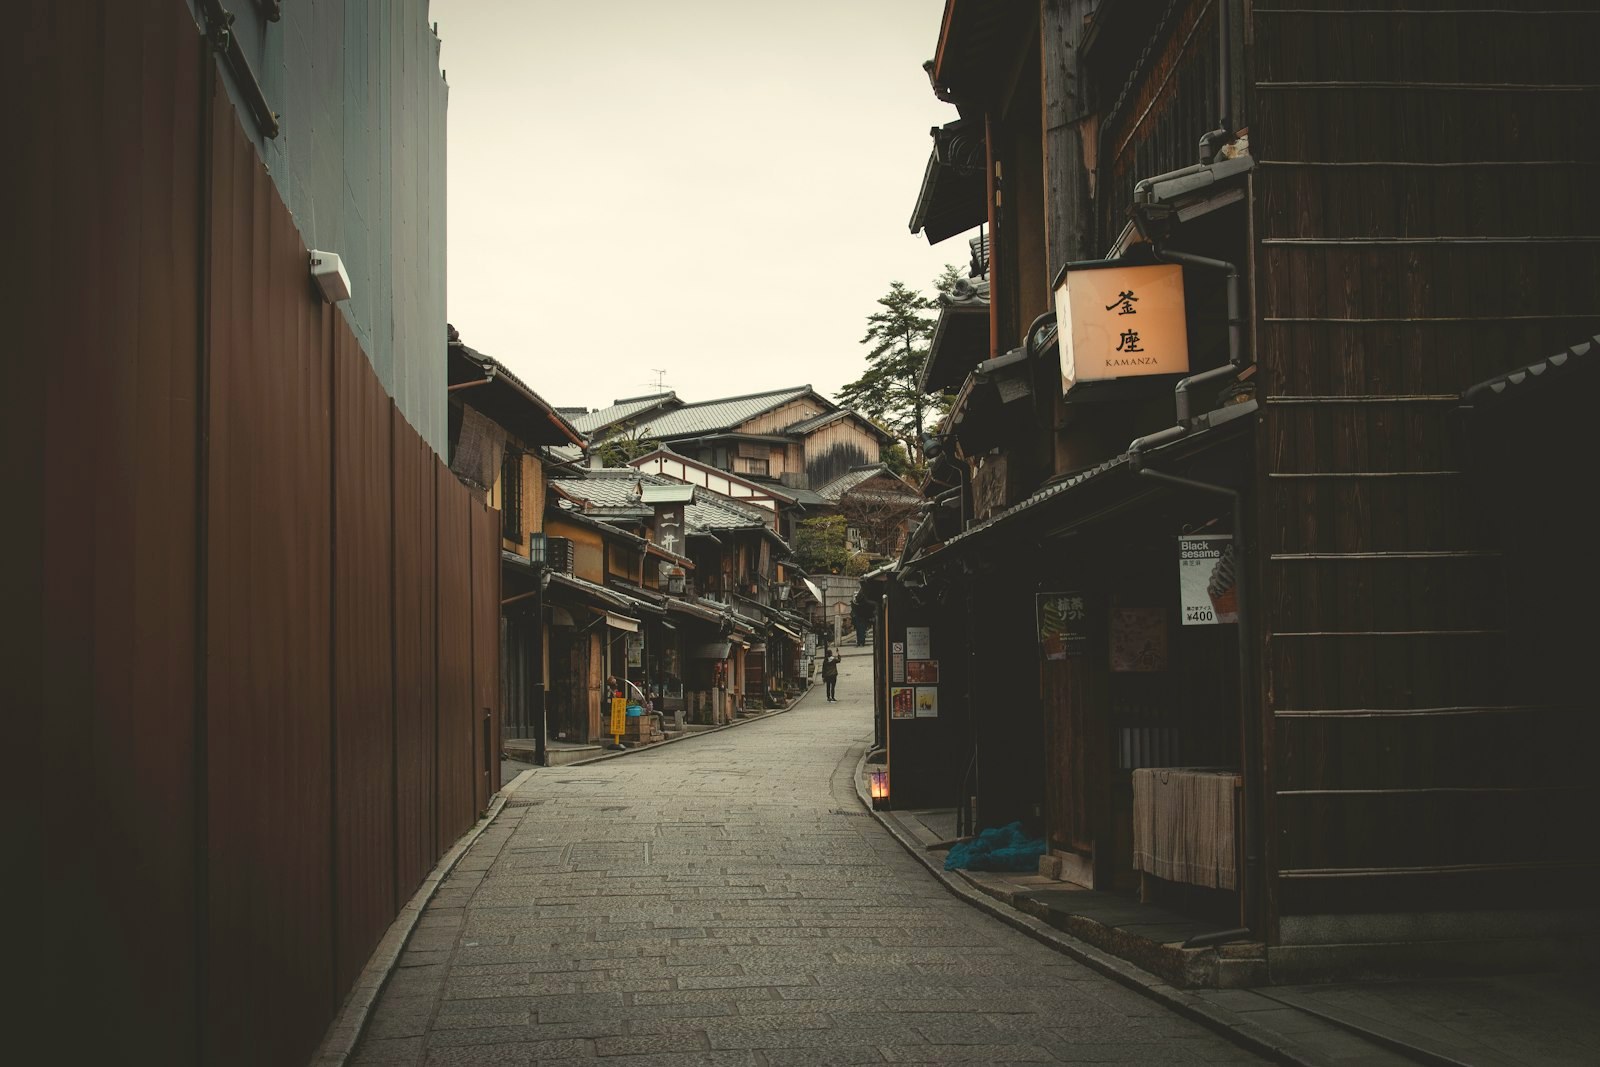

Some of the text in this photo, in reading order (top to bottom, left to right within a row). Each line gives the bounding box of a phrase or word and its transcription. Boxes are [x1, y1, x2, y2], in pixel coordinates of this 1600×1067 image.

[1105, 290, 1144, 353] 釜座
[1105, 357, 1158, 367] KAMANZA
[1181, 541, 1209, 550] Black
[1181, 550, 1220, 558] sesame
[1057, 597, 1083, 611] 抹茶
[1058, 610, 1085, 621] ソフト
[1187, 611, 1212, 621] ¥400
